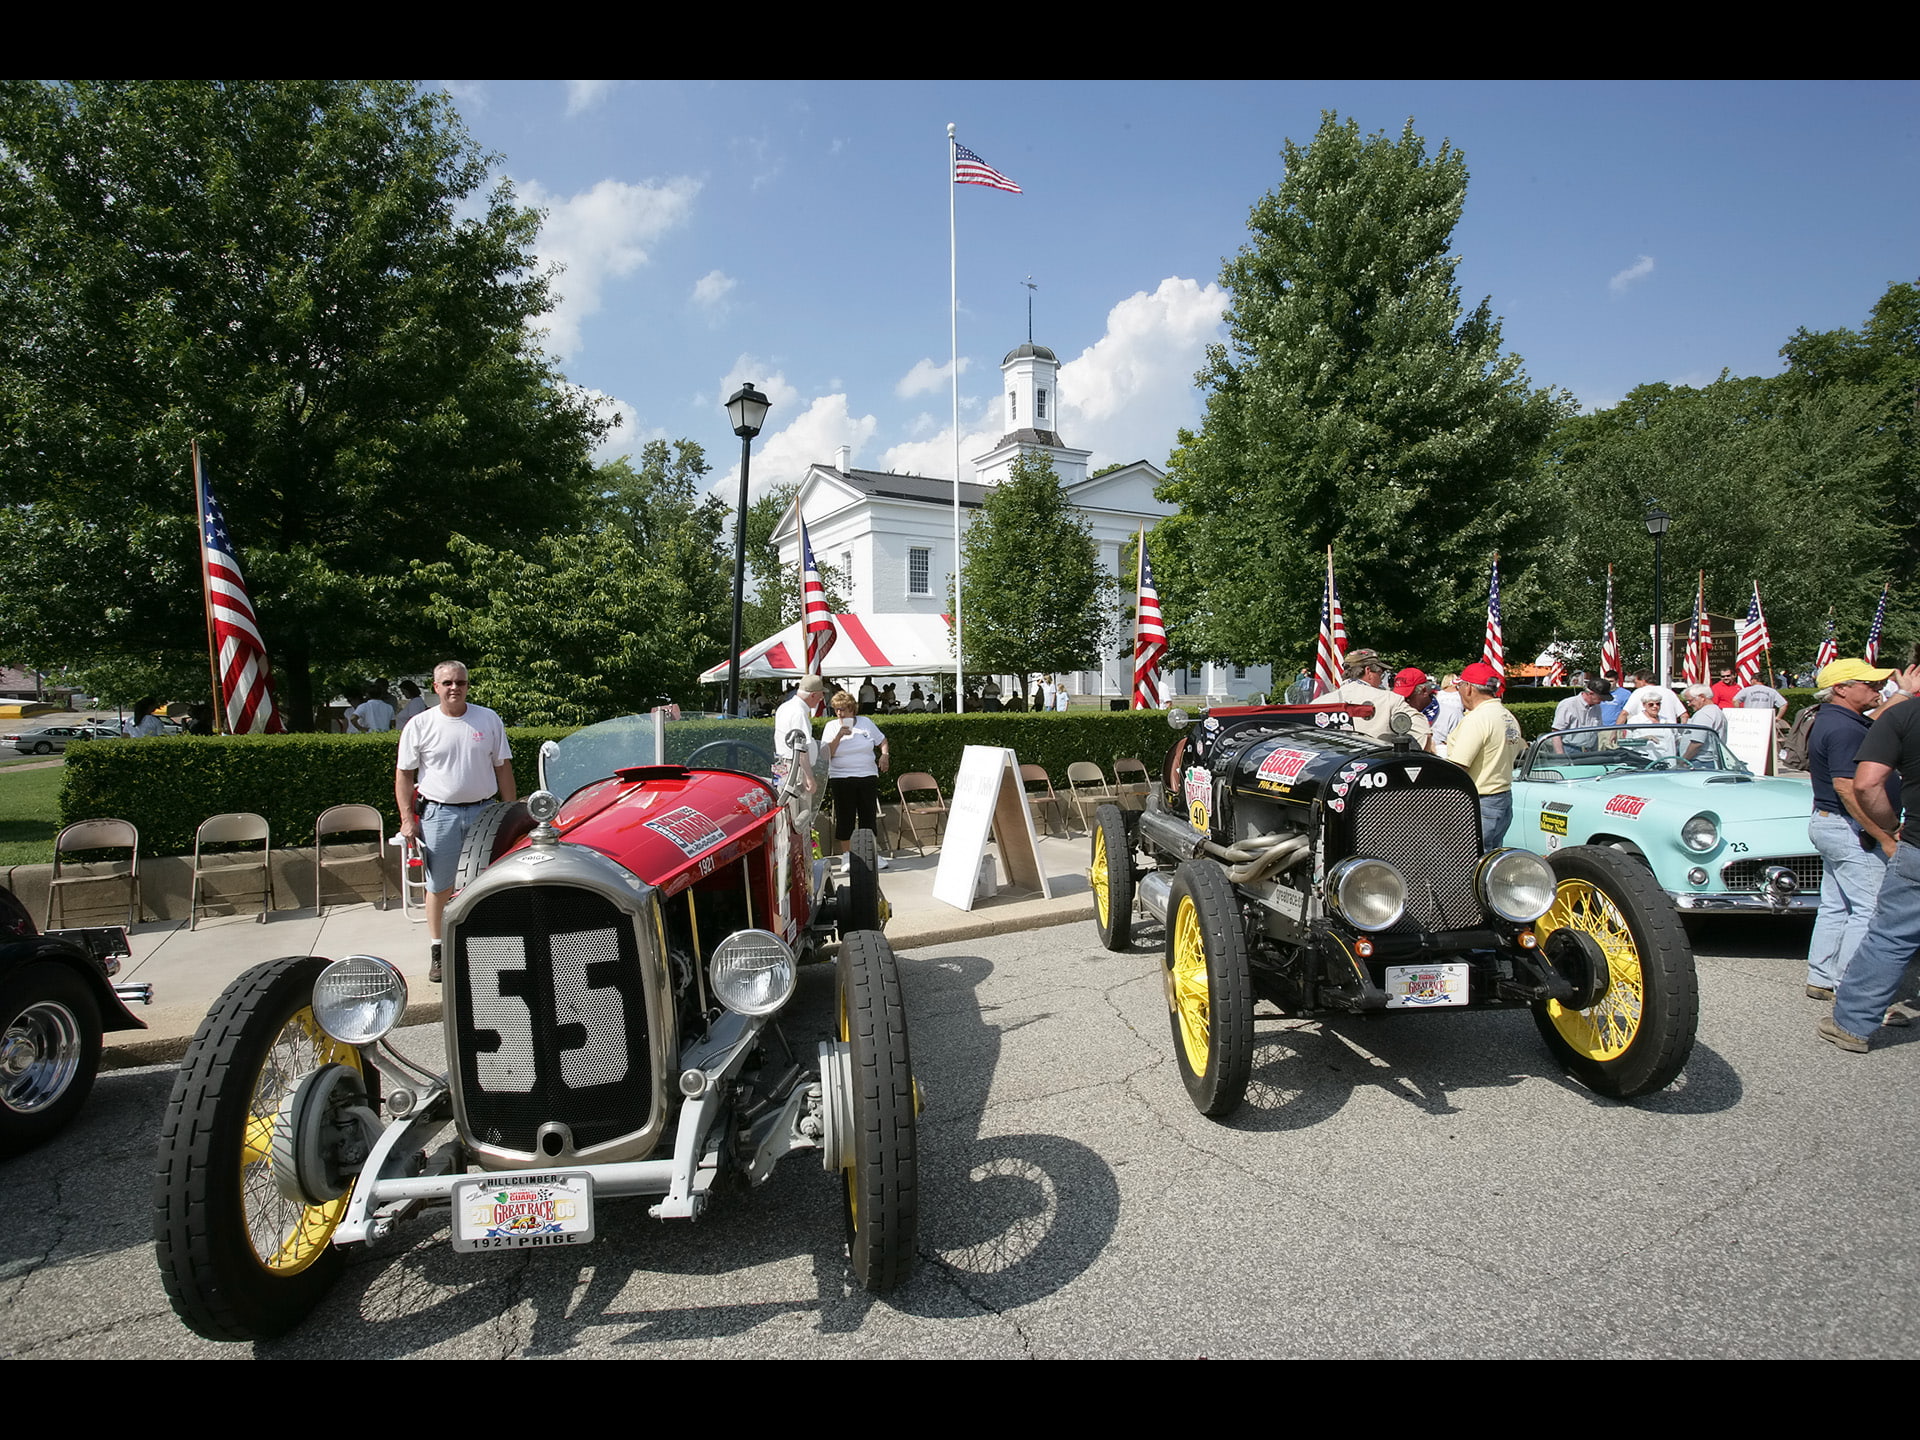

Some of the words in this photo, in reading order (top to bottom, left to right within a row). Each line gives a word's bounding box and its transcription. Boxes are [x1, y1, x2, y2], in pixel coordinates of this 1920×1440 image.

[1329, 712, 1350, 724] 40
[1261, 755, 1306, 777] GUARD
[1271, 781, 1291, 793] Hudson
[1359, 771, 1388, 789] 40
[1605, 797, 1645, 815] GUARD
[1193, 807, 1205, 827] 40
[668, 814, 719, 845] GUARD
[1730, 842, 1749, 853] 23
[698, 854, 716, 876] 1921
[1408, 980, 1429, 994] GREAT
[1428, 980, 1445, 993] RACE
[466, 927, 629, 1093] 55
[487, 1174, 558, 1187] HILLCLIMBER
[509, 1193, 537, 1201] GUARD
[472, 1208, 491, 1224] 20
[493, 1203, 526, 1225] GREAT
[527, 1201, 555, 1221] RACE
[557, 1202, 576, 1218] 06
[472, 1236, 512, 1248] 1921
[518, 1233, 577, 1247] PAIGE
